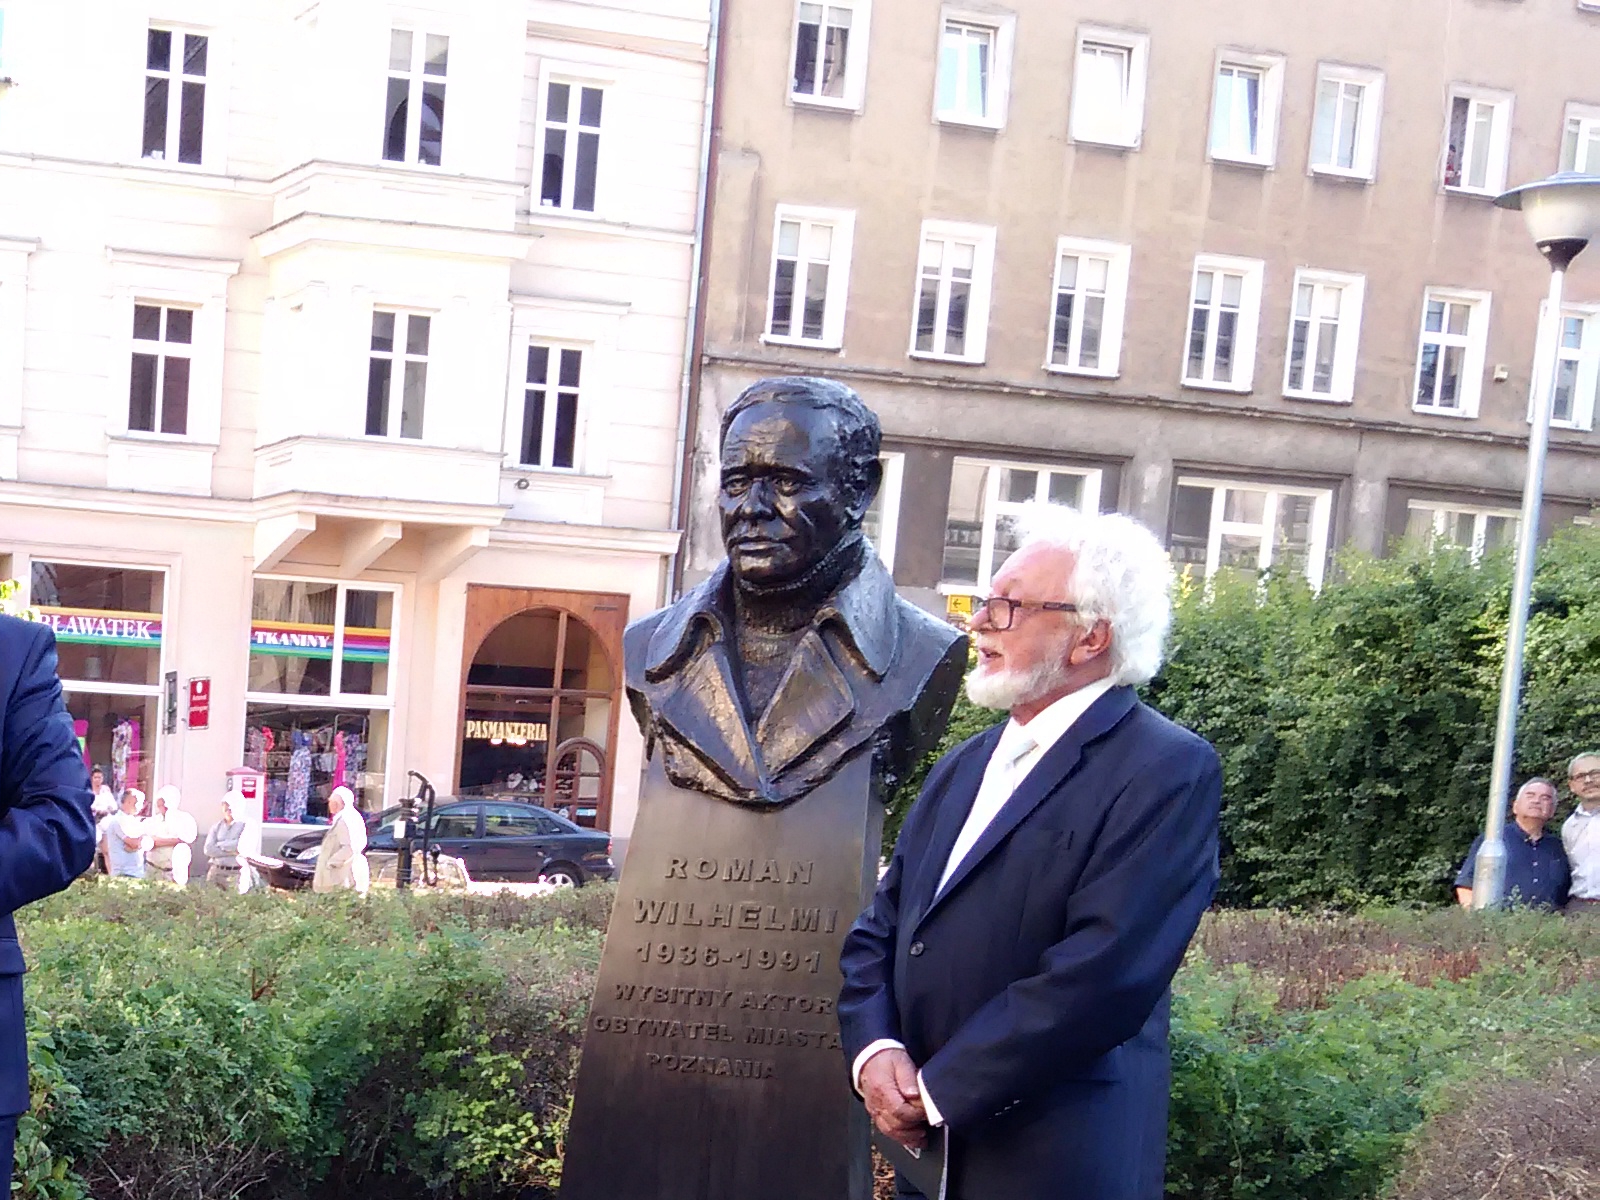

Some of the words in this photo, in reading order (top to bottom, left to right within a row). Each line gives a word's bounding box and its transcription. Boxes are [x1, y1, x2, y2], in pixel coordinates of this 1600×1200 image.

[254, 630, 330, 648] TKANINY
[466, 720, 547, 741] PASMANTERIA
[665, 857, 813, 884] ROMAN
[632, 898, 838, 933] WILHELMI
[636, 942, 821, 973] 1936-1991
[616, 984, 732, 1010] WYBITNY
[739, 992, 833, 1015] AKTOR
[593, 1015, 733, 1042] OBYWATEL
[646, 1052, 778, 1080] POZNANIA
